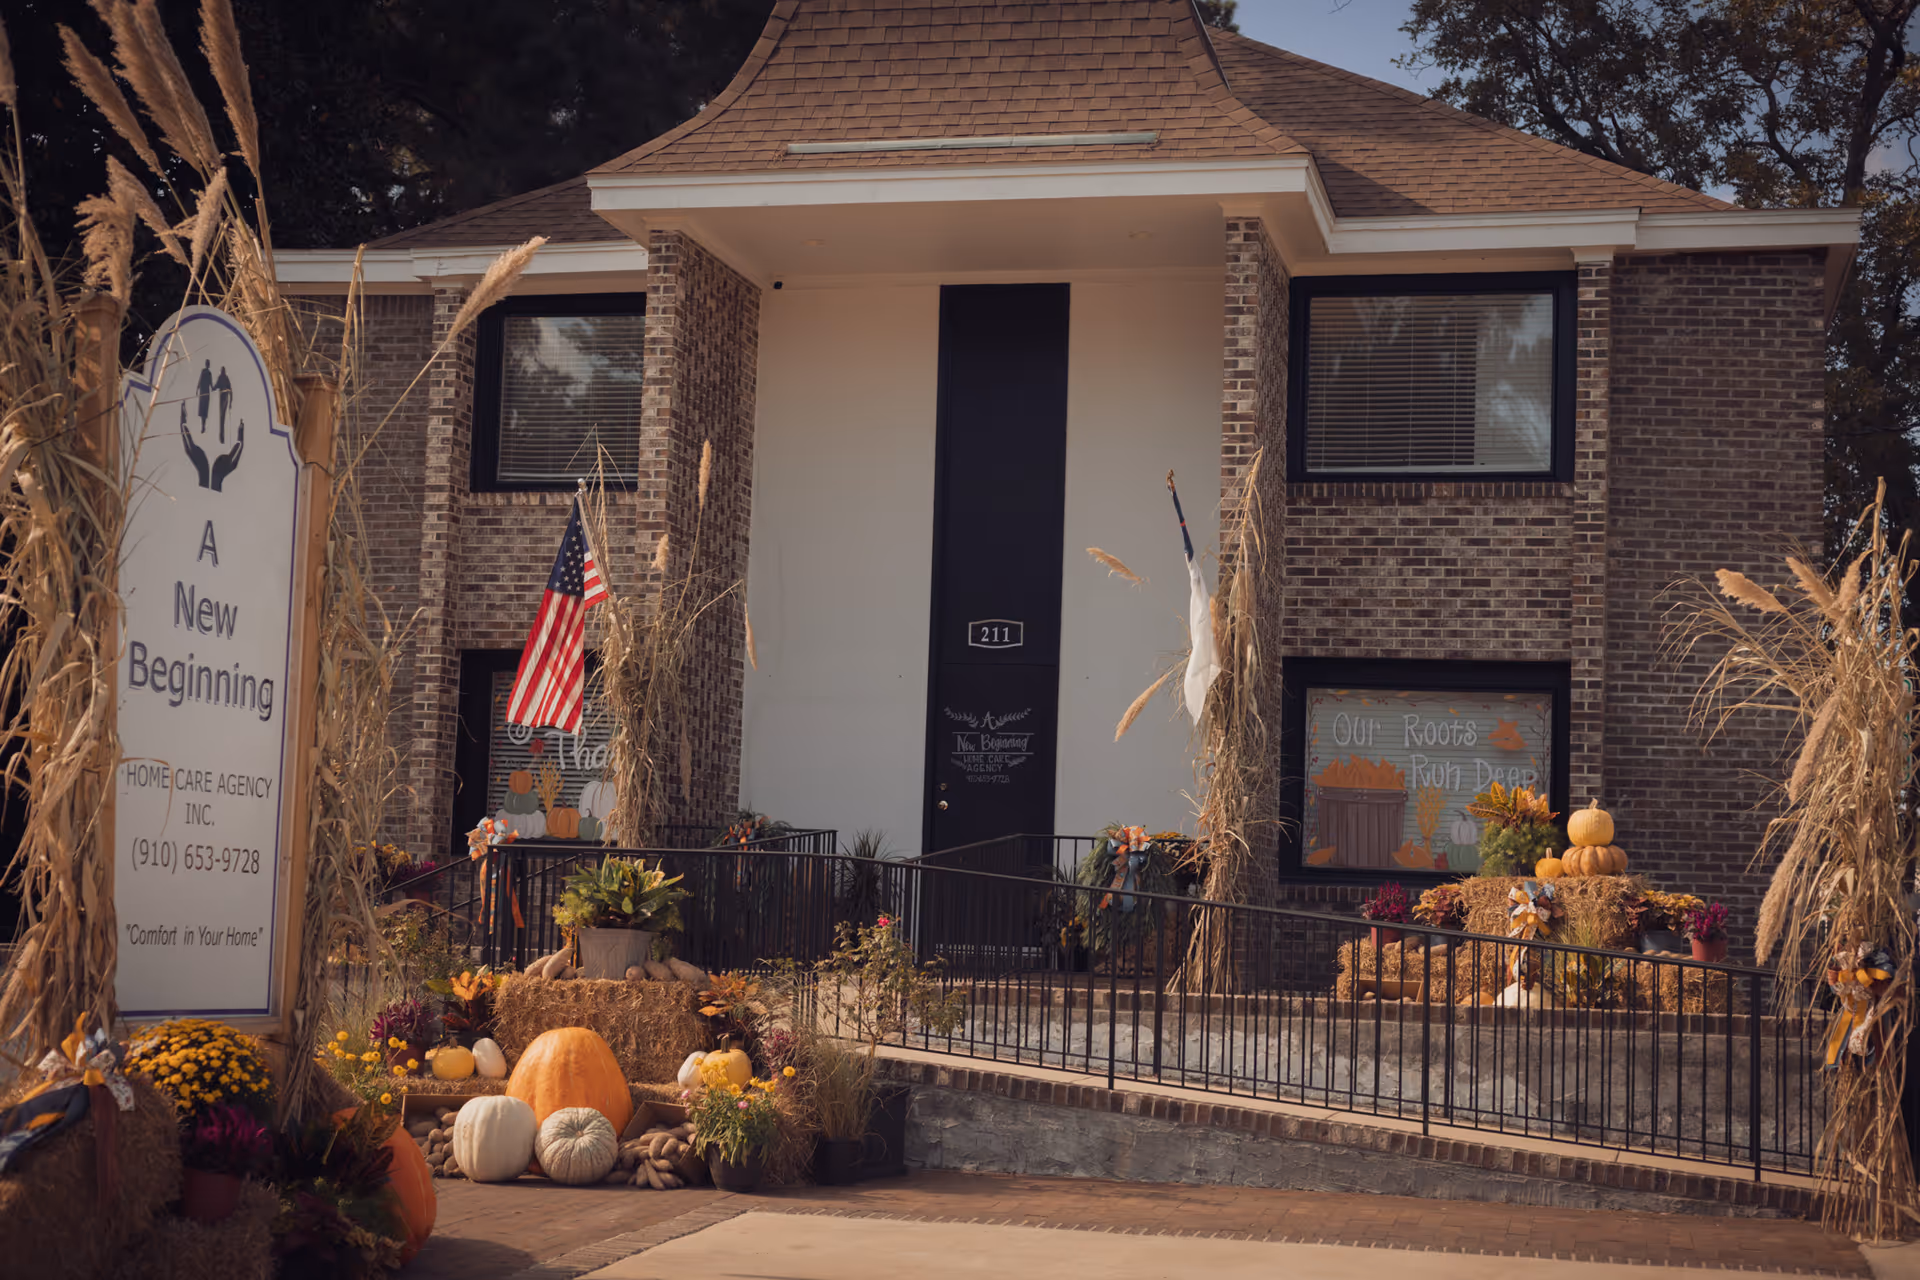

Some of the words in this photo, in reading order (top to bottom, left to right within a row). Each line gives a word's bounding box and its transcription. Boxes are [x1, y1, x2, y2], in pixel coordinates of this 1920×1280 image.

[197, 520, 219, 568] A
[174, 580, 238, 640] New
[981, 626, 1010, 642] 211
[128, 640, 274, 722] Beginning
[980, 711, 996, 730] A
[1333, 712, 1383, 746] Our
[1403, 713, 1478, 748] Roots
[957, 733, 976, 752] New
[981, 733, 1029, 751] Beginning
[963, 755, 985, 763] HOME
[988, 755, 1009, 763] CARE
[966, 764, 1003, 772] AGENCY
[1410, 754, 1461, 792] Run
[126, 763, 170, 789] HOME
[175, 768, 212, 793] CARE
[216, 773, 273, 799] AGENCY
[185, 802, 215, 827] INC.
[131, 837, 178, 874] (910)
[184, 843, 260, 874] 653-9728
[126, 923, 177, 945] "Comfort
[183, 926, 195, 946] in
[198, 925, 223, 946] Your
[225, 926, 263, 947] Home"
